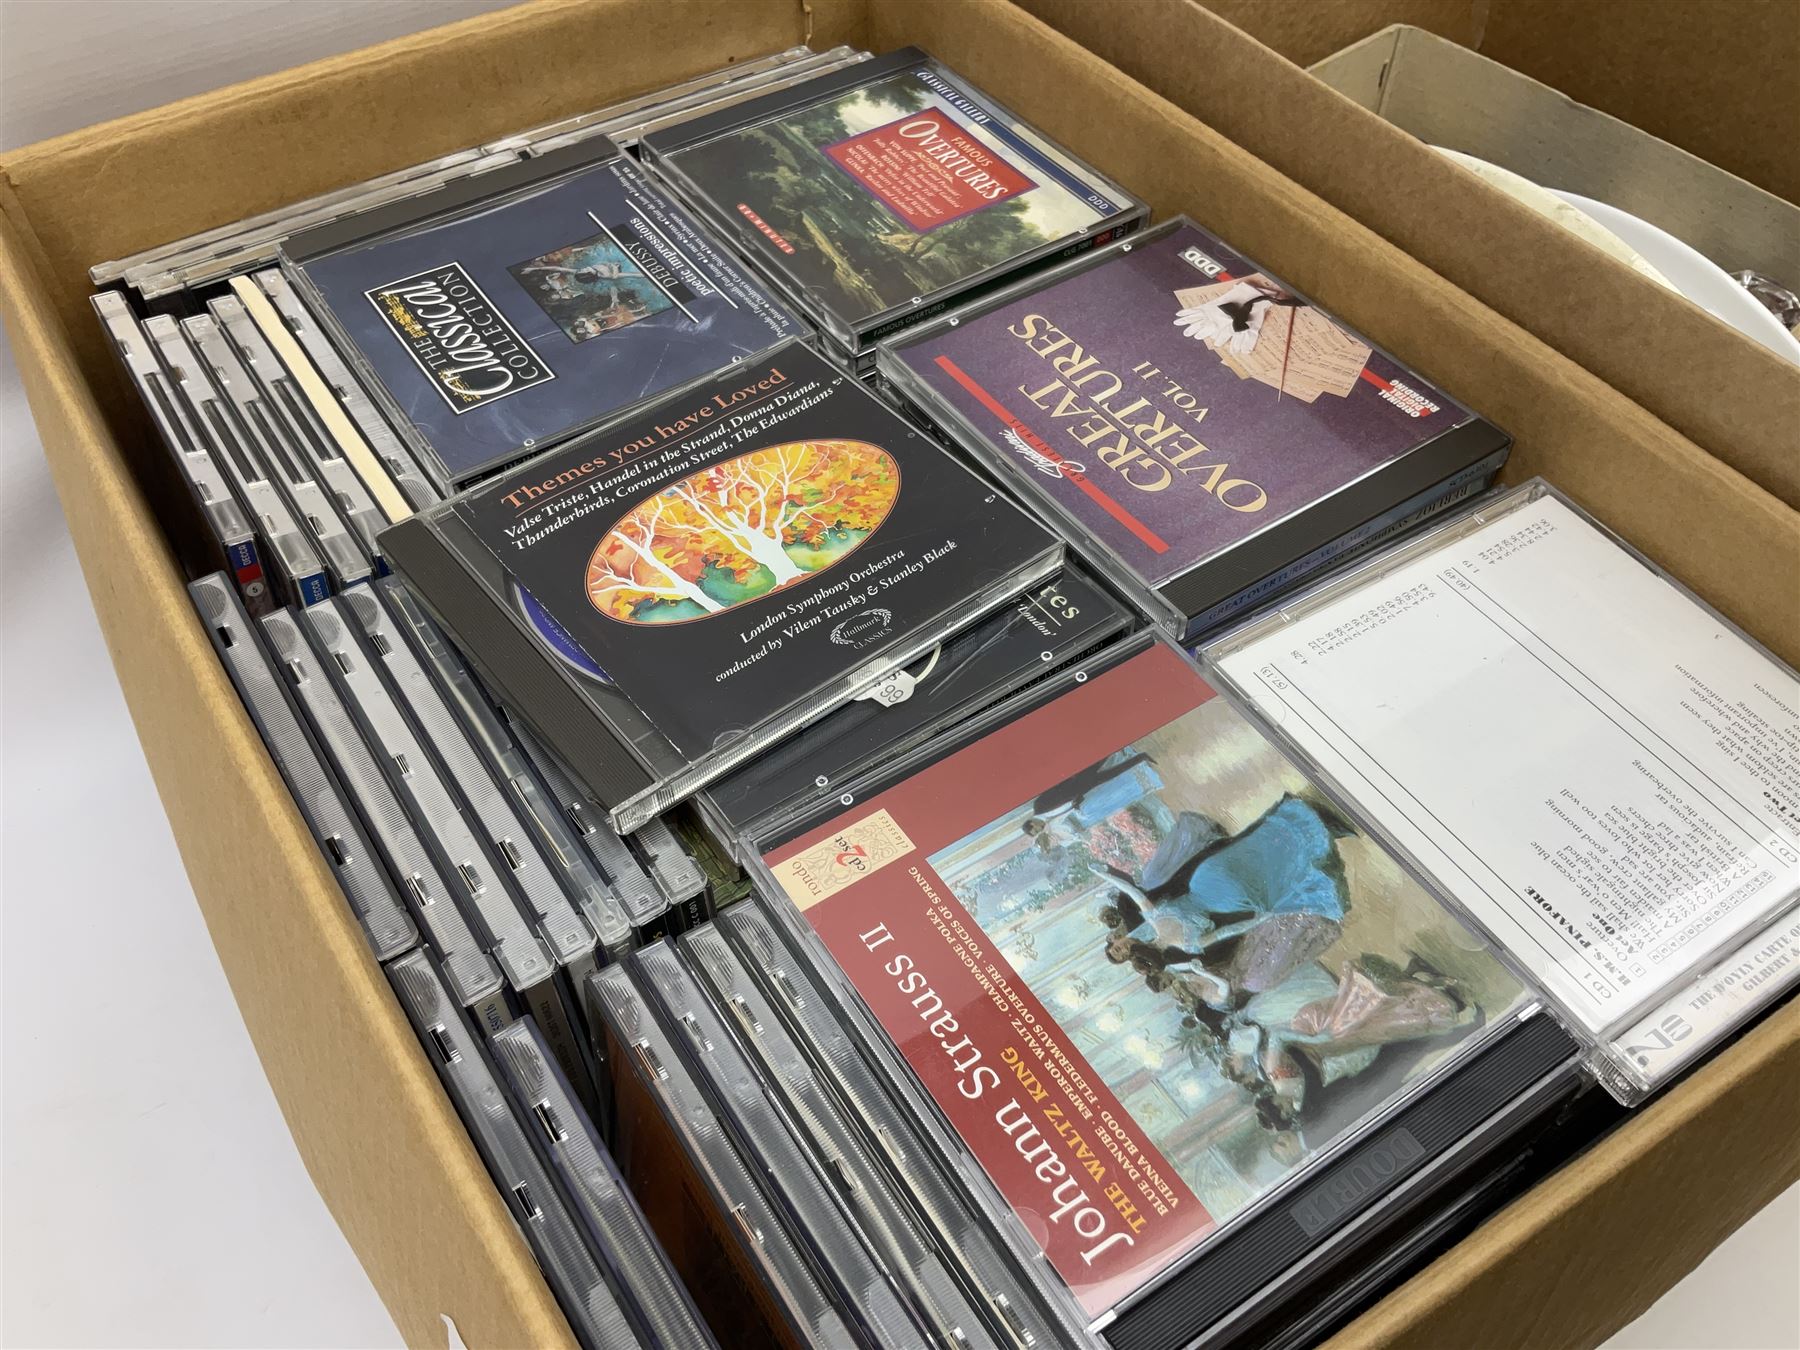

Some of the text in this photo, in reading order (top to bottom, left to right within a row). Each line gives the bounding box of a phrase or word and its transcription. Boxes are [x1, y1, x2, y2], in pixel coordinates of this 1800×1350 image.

[899, 121, 1008, 199] OVERTURES
[951, 137, 992, 166] FAMOUS
[1084, 194, 1112, 210] DDD
[626, 242, 678, 287] DEBUSSY
[631, 218, 715, 296] poetic impressions
[1179, 248, 1224, 275] DDD
[378, 273, 520, 406] Classical
[438, 272, 538, 379] COLLECTION
[414, 338, 447, 369] THE
[1132, 361, 1208, 423] VOL. II
[1375, 388, 1422, 418] ORIGINAL
[1387, 378, 1442, 413] RECORDING
[1387, 387, 1425, 411] DIGITAL
[1007, 315, 1267, 512] OVERTURES
[501, 458, 606, 508] Themes
[608, 437, 656, 463] you
[654, 407, 713, 439] have
[712, 369, 786, 409] Loved
[1018, 378, 1171, 491] GREAT
[504, 382, 819, 537] Valse Triste, Handel in the Strand, Donna Diana,
[512, 388, 833, 549] Thunderbirds, Coronation Street, The Edwardians
[238, 544, 252, 566] DECCA
[311, 580, 324, 601] DECCA
[740, 551, 904, 643] London Symphony Orchestra
[716, 540, 957, 682] conducted by Vilem Tausky & Stanley Black
[841, 613, 881, 639] Hallmark
[851, 624, 893, 651] CLASSICS
[1628, 758, 1685, 805] overbearing
[1608, 804, 1631, 822] seen
[1680, 803, 1699, 818] the
[874, 814, 910, 851] classics
[1635, 828, 1666, 853] barge
[1653, 792, 1751, 875] Refrain, audacious tar
[1695, 816, 1733, 846] survive
[831, 834, 868, 873] cd 2 set
[1542, 797, 1685, 923] My gallant crew, good morning
[1554, 849, 1576, 868] men
[1661, 850, 1705, 887] Joseph's
[1735, 850, 1759, 869] Can
[1776, 845, 1799, 863] CD
[785, 859, 824, 898] rondo
[1527, 840, 1648, 948] We shall sail the ocean blue
[1562, 843, 1665, 936] The nightingale sighed
[1572, 867, 1610, 900] o'war's
[1699, 884, 1718, 899] Sir
[1607, 898, 1632, 920] Men
[1522, 884, 1632, 986] H.M.S. PINAFORE
[1582, 919, 1630, 963] Overture
[1588, 911, 1638, 956] Act One
[1590, 979, 1614, 1000] CD
[1688, 932, 1791, 1013] THE D'OYLY CARTE
[1741, 952, 1791, 992] GILBERT
[909, 867, 1178, 1208] VIENNA BLOOD FLEDERMAUS OVERTURE VOICES OF SPRING
[927, 908, 1168, 1216] BLUE DANUBE EMPEROR WALTZ CHAMPAGNE POLKA
[859, 922, 1134, 1266] Johann Strauss II
[1001, 1047, 1146, 1233] THE WALTZ KING
